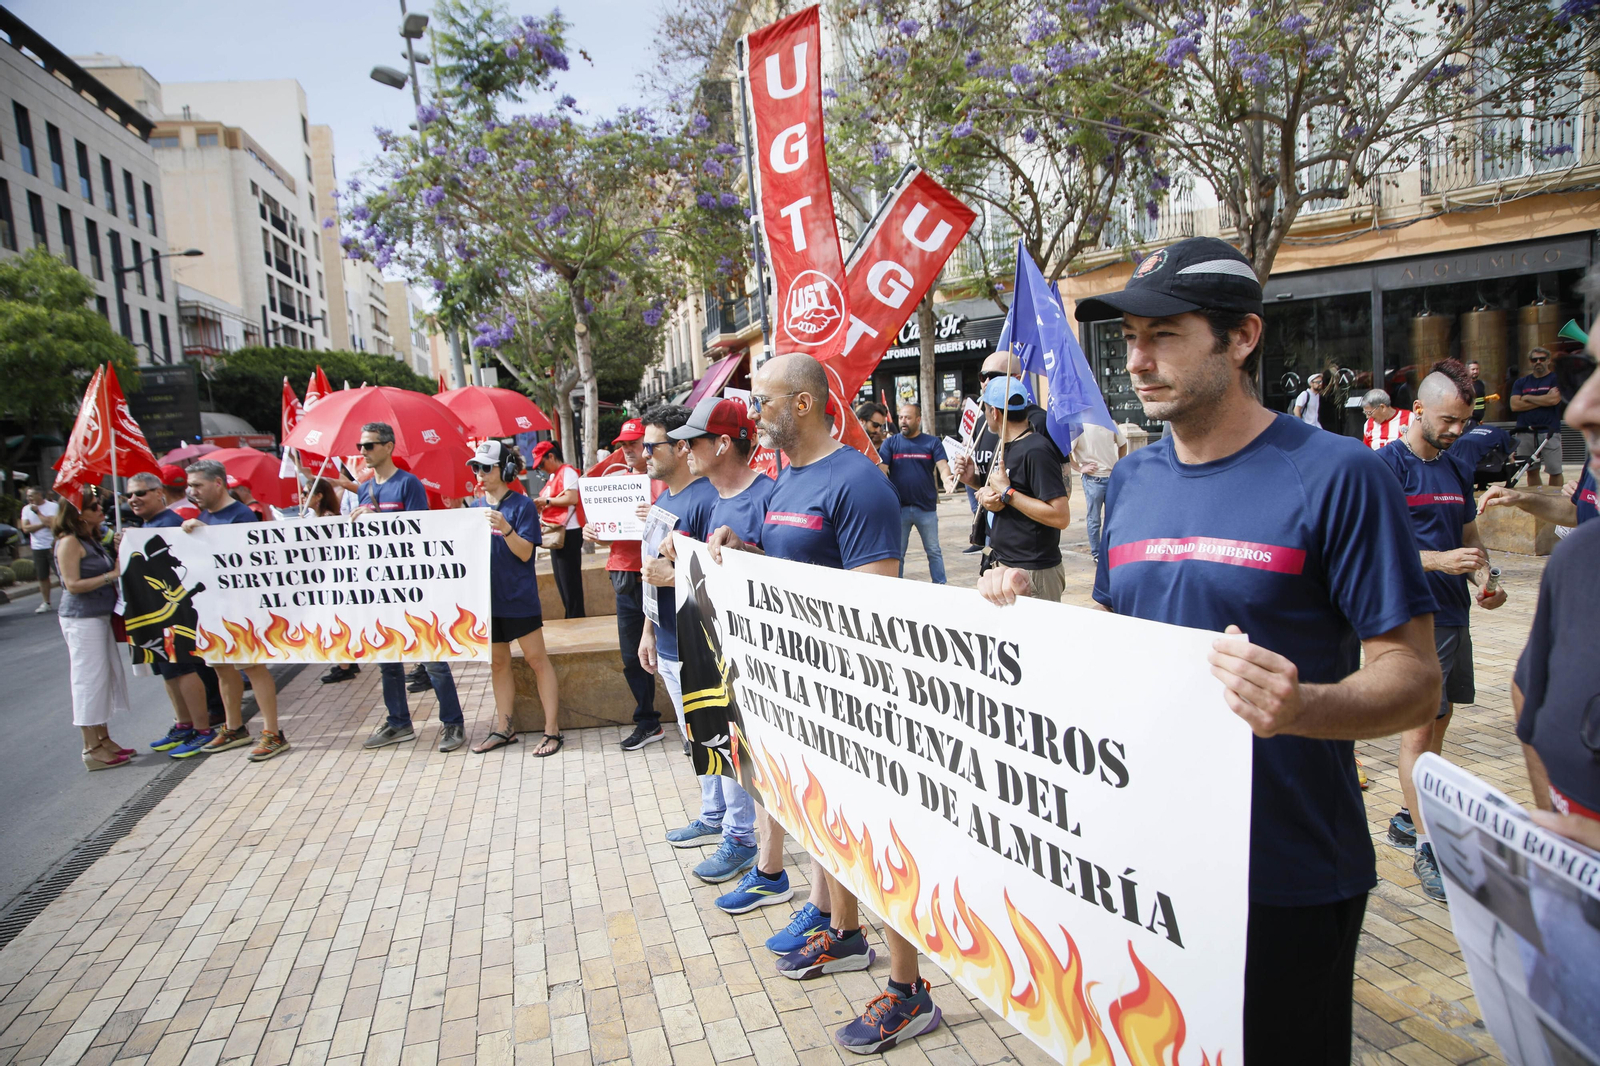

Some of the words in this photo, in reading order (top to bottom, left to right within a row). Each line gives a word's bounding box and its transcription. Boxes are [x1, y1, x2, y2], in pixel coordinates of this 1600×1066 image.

[765, 41, 812, 253] UGT
[791, 280, 832, 313] UGT
[934, 341, 964, 354] RGERS
[965, 338, 987, 350] 1941
[594, 496, 633, 504] DERECHOS
[247, 528, 286, 545] SIN
[295, 516, 422, 542] INVERSIÓN
[213, 553, 243, 569] NO
[250, 551, 278, 567] SE
[284, 545, 360, 564] PUEDE
[368, 541, 415, 560] DAR
[423, 540, 455, 557] UN
[1145, 542, 1195, 555] DIGNIDAD
[1197, 543, 1272, 563] BOMBEROS
[217, 568, 325, 589] SERVICIO
[333, 566, 359, 583] DE
[366, 562, 467, 582] CALIDAD
[259, 593, 288, 609] AL
[292, 586, 424, 607] CIUDADANO
[747, 579, 784, 614] LAS
[783, 589, 1022, 686] INSTALACIONES
[726, 610, 757, 646] DEL
[760, 622, 855, 680] PARQUE
[856, 652, 899, 697] DE
[902, 667, 1130, 788] BOMBEROS
[745, 653, 778, 693] SON
[782, 669, 811, 708] LA
[813, 681, 988, 791] VERGÜENZA
[995, 759, 1082, 837] DEL
[741, 685, 909, 796] AYUNTAMIENTO
[917, 771, 959, 828] DE
[967, 803, 1185, 949] ALMERÍA
[1423, 771, 1516, 841] DIGNIDAD
